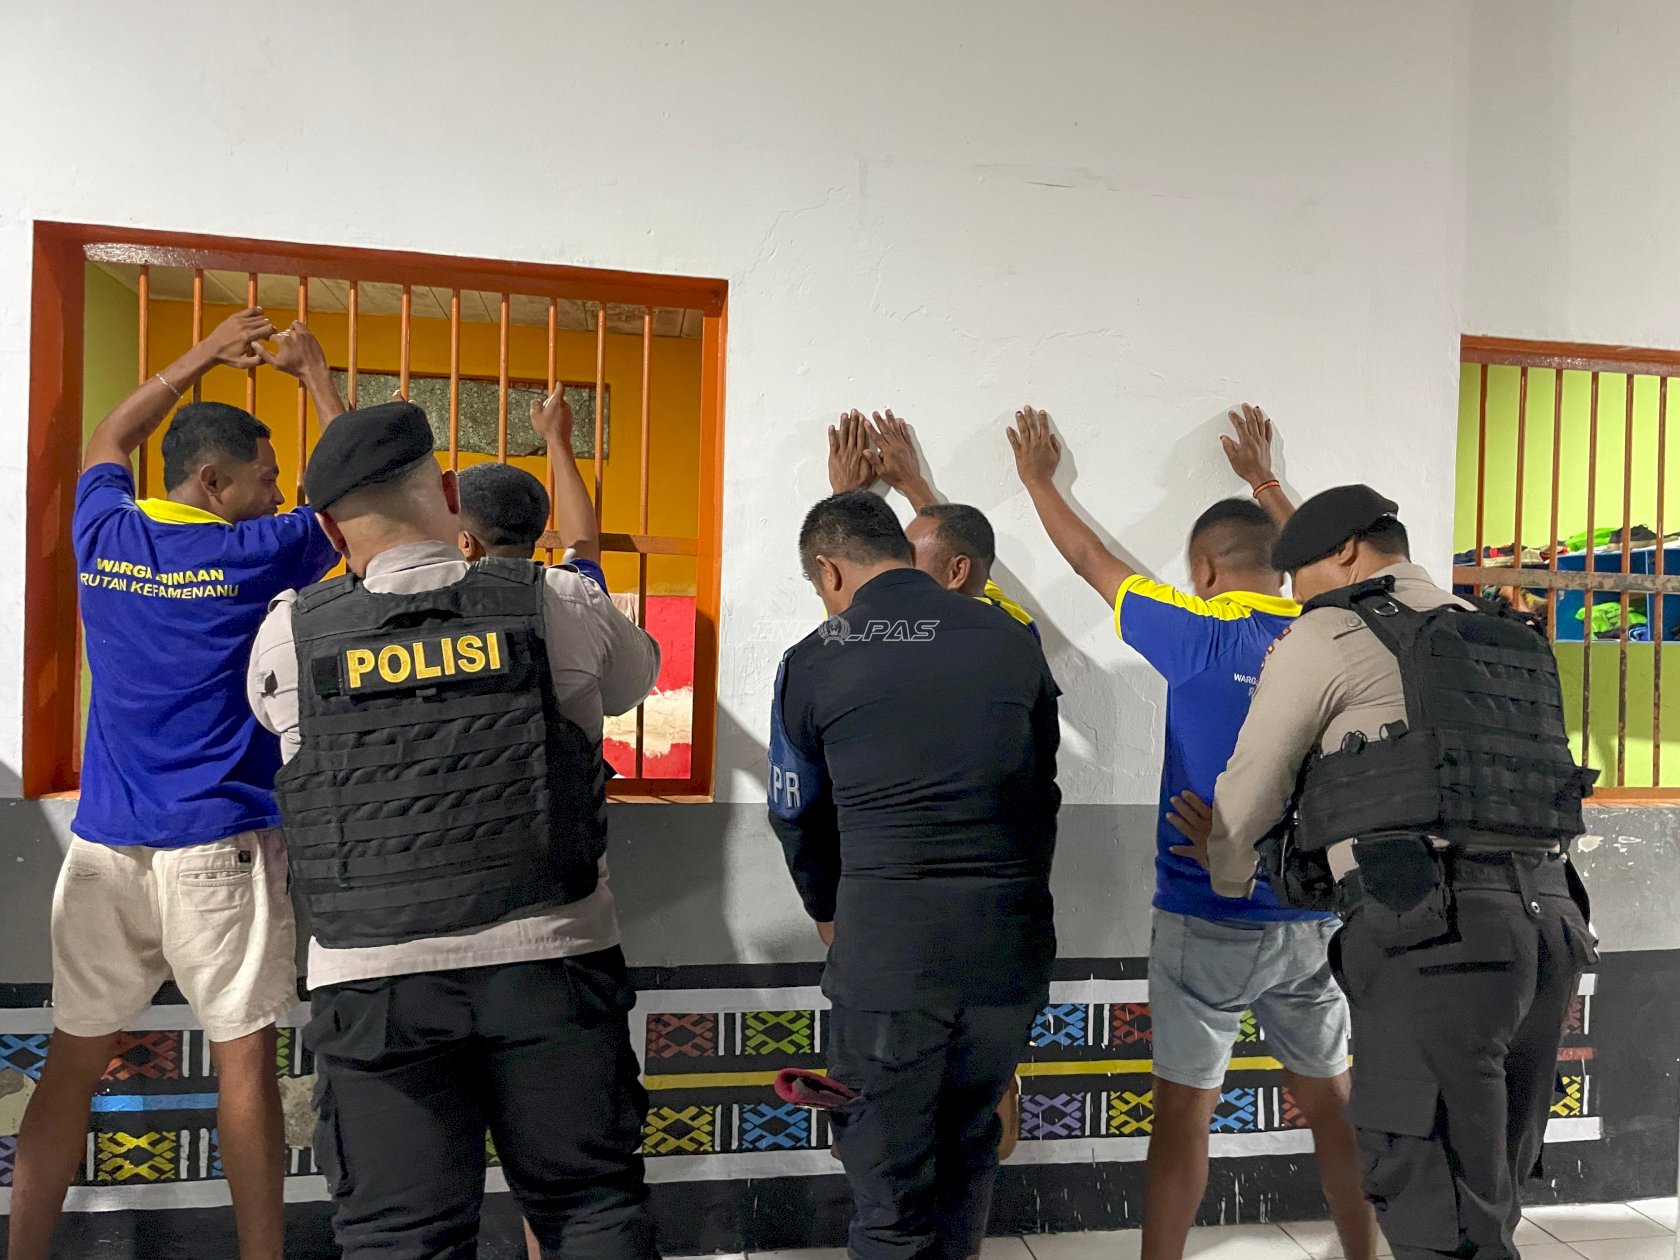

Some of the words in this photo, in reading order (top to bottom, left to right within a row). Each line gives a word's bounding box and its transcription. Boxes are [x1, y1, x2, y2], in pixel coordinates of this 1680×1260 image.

[97, 557, 153, 579] WARGA
[80, 572, 127, 591] RUTAN
[130, 580, 239, 599] KEFAMENANU
[346, 632, 501, 688] POLISI
[1233, 672, 1259, 685] WARG
[767, 762, 801, 808] PR
